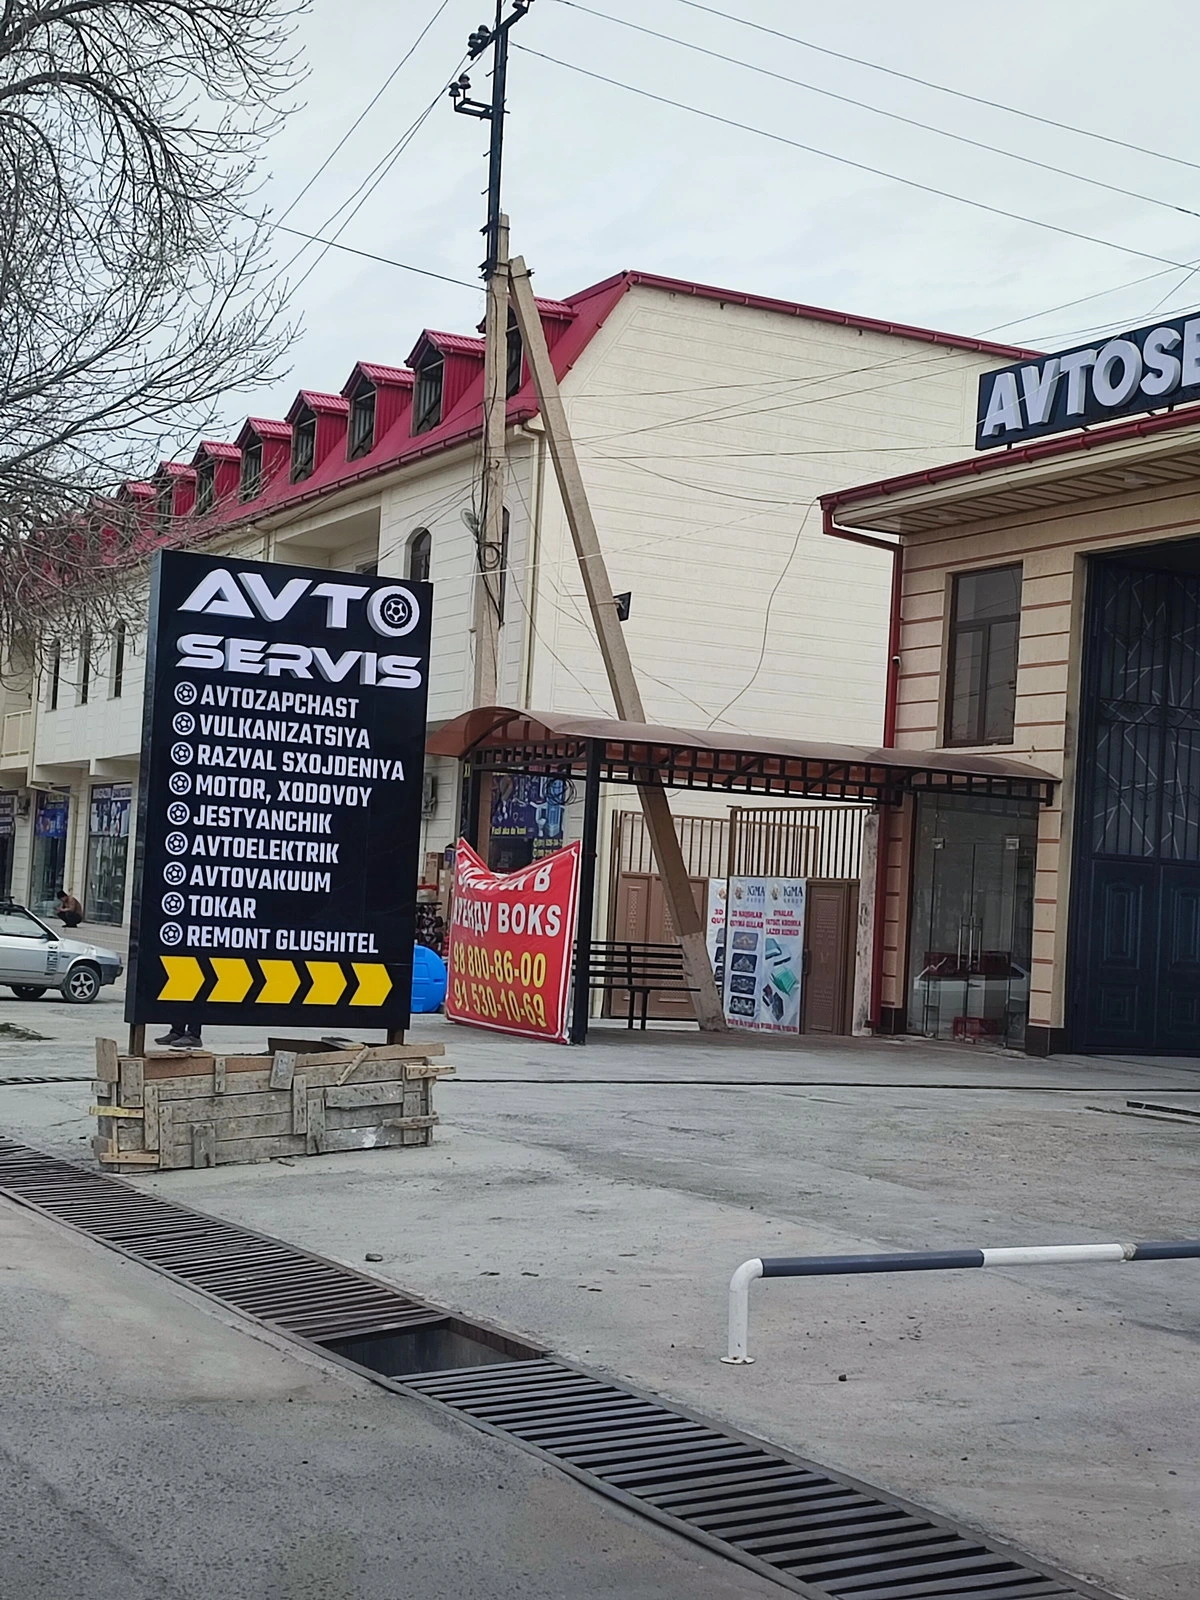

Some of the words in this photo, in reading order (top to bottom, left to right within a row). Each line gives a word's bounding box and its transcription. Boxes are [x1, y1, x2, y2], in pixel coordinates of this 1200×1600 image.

[177, 568, 420, 638] AVTO
[175, 633, 422, 689] SERVIS
[200, 684, 359, 719] AVTOZAPCHAST
[199, 714, 371, 749] VULKANIZATSIYA
[196, 744, 277, 772] RAZVAL
[282, 752, 405, 781] SXOJDENIYA
[195, 774, 271, 805] MOTOR,
[277, 781, 372, 808] XODOVOY
[192, 805, 332, 834] JESTYANCHIK
[191, 834, 340, 864] AVTOELEKTRIK
[189, 865, 331, 893] AVTOVAKUUM
[188, 895, 256, 919] TOKAR
[497, 902, 562, 937] BOKS
[186, 925, 271, 950] REMONT
[275, 929, 379, 954] GLUSHITEL
[453, 941, 466, 975] 98
[467, 944, 547, 988] 800-86-00
[454, 978, 470, 1012] 91
[471, 982, 547, 1028] 530-10-69
